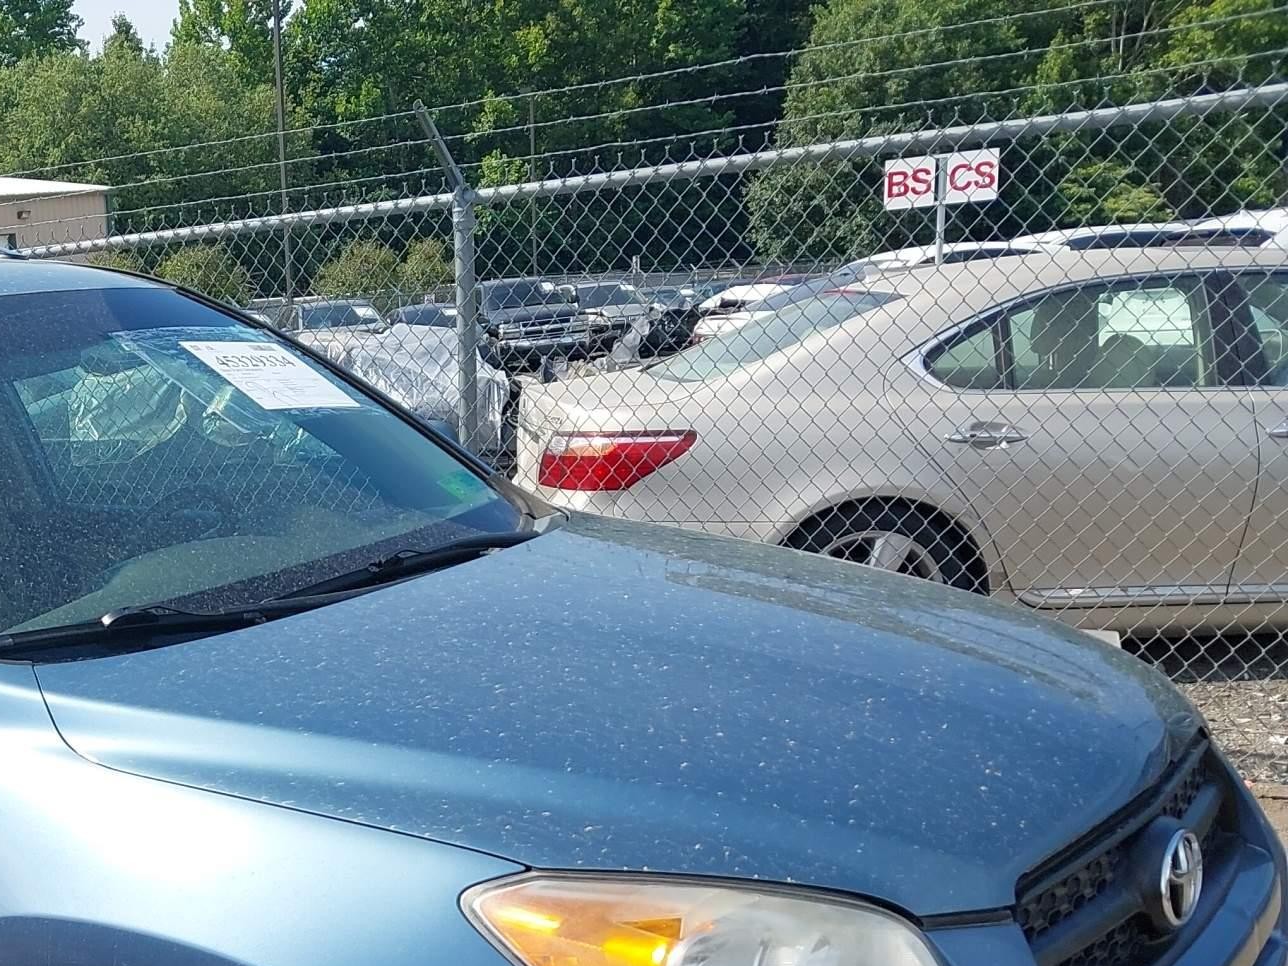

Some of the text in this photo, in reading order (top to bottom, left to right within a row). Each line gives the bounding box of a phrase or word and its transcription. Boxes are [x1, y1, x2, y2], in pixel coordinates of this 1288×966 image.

[887, 168, 931, 198] BS
[949, 161, 995, 191] CS
[216, 356, 295, 369] 45329334
